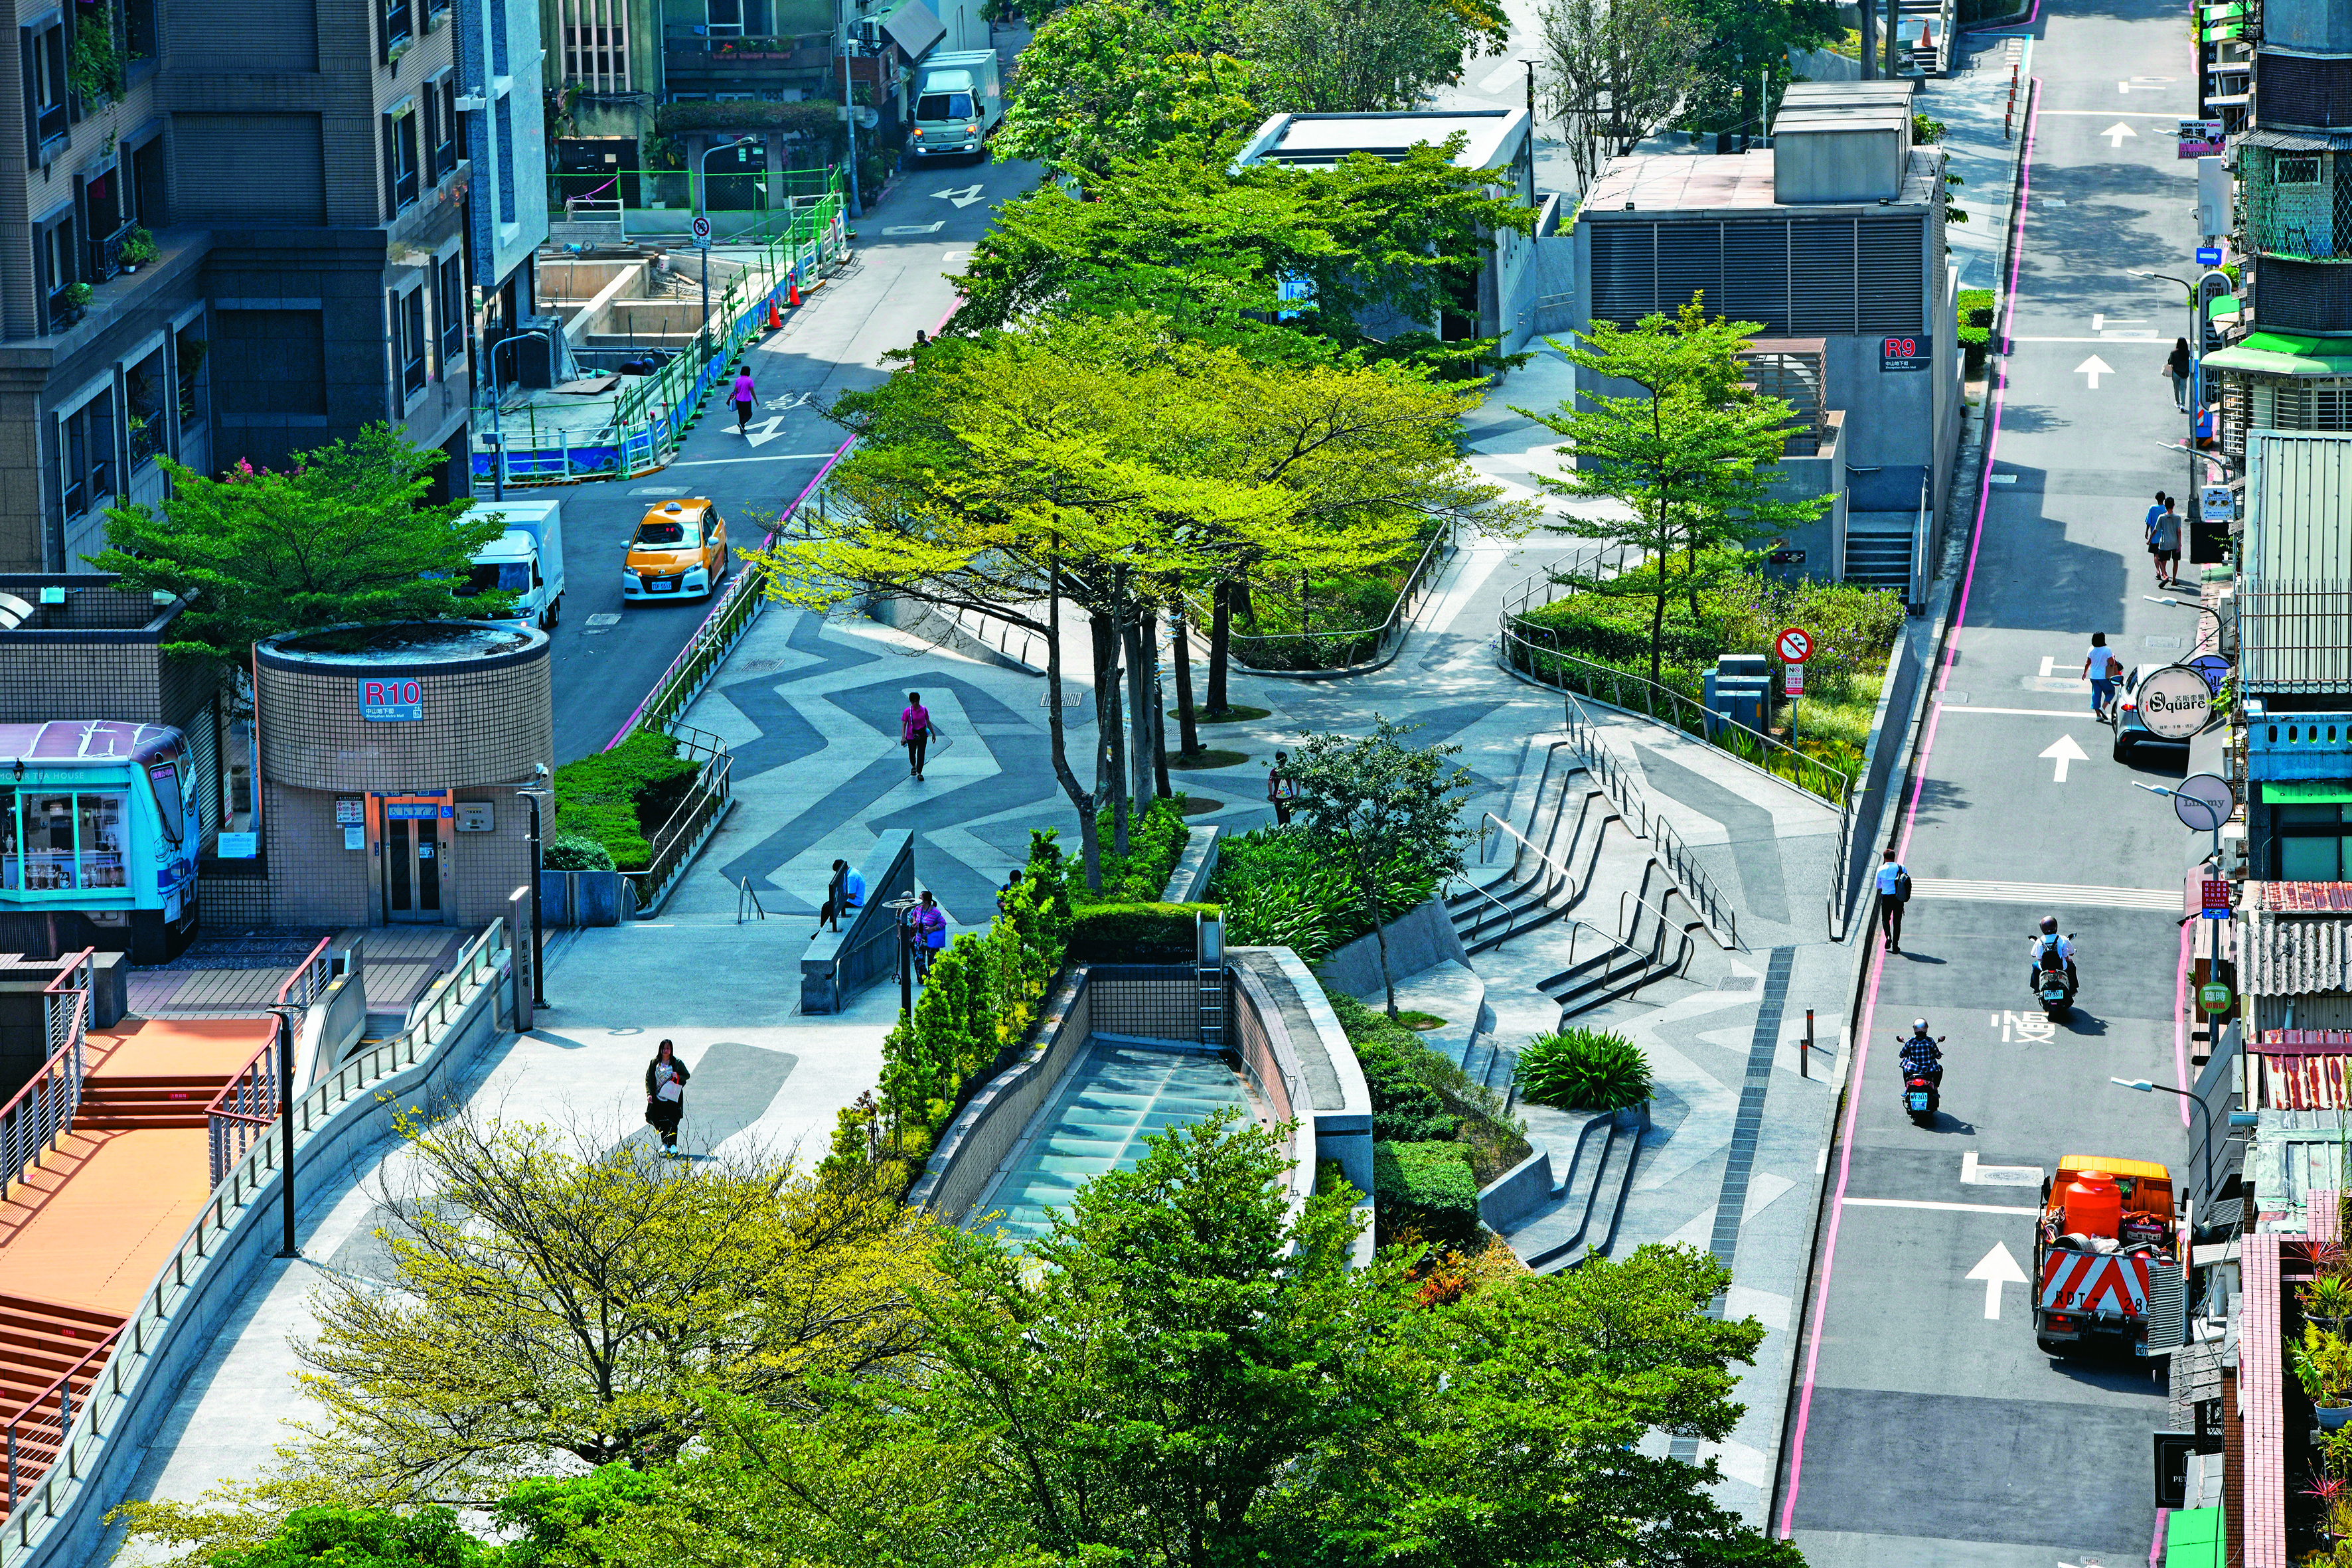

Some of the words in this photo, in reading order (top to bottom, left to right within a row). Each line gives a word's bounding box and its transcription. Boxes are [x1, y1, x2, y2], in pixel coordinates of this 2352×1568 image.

[1885, 339, 1915, 357] R9
[364, 681, 420, 705] R10
[2205, 990, 2226, 1001] 臨時
[1990, 1010, 2055, 1044] 慢
